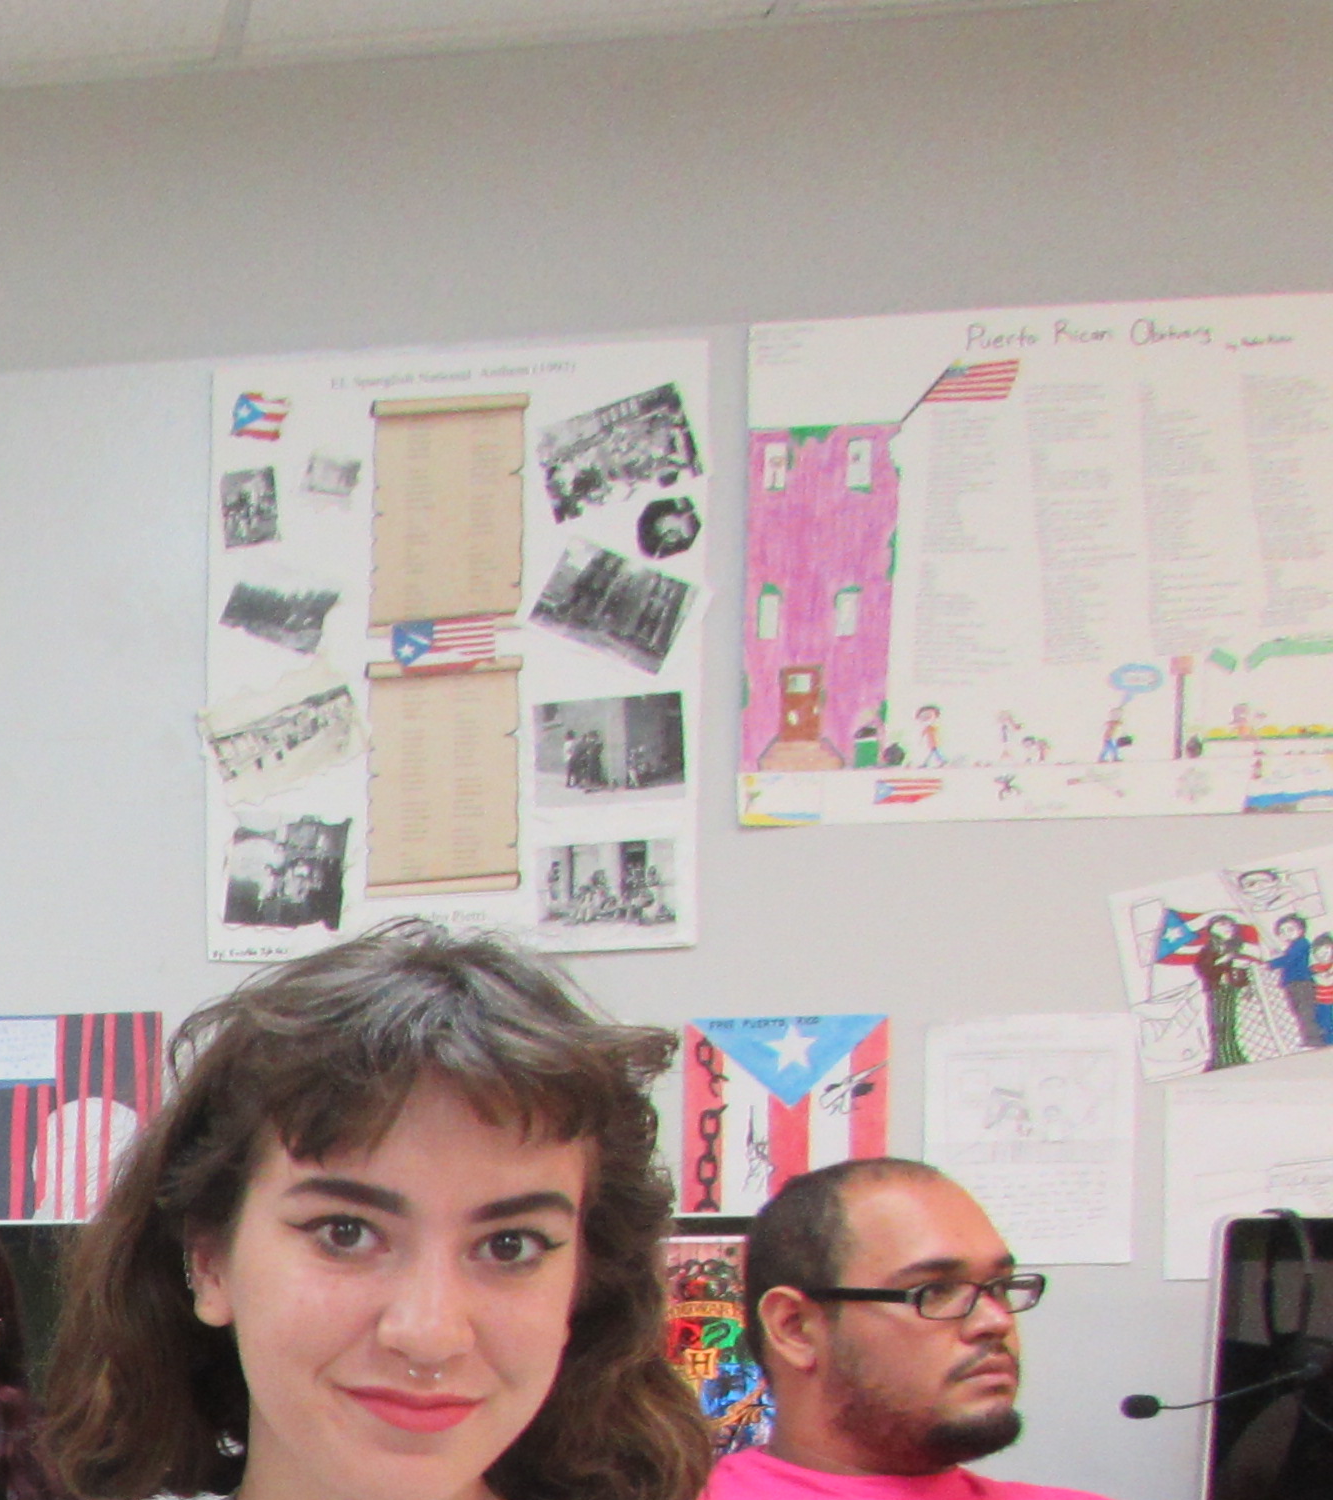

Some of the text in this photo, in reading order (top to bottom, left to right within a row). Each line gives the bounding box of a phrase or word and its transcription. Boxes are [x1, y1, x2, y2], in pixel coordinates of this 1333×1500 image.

[966, 322, 1039, 350] Puerto
[1054, 319, 1110, 345] Rican
[419, 370, 471, 383] National
[689, 1352, 713, 1377] H
